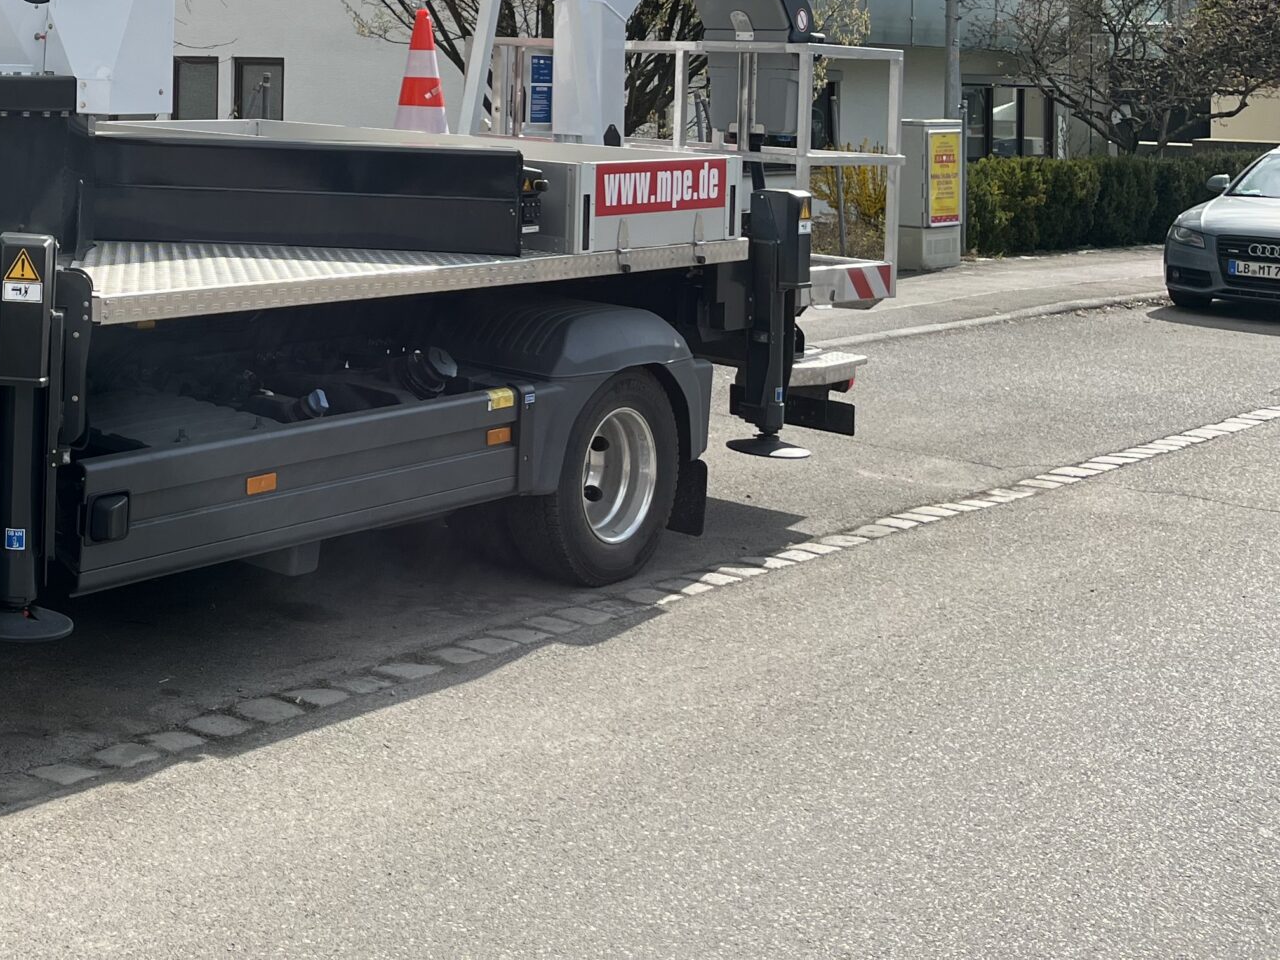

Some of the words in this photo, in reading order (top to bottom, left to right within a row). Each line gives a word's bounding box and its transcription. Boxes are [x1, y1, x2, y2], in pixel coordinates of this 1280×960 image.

[604, 162, 719, 209] www.mpe.de
[1236, 263, 1250, 274] LB
[1258, 264, 1272, 276] MT
